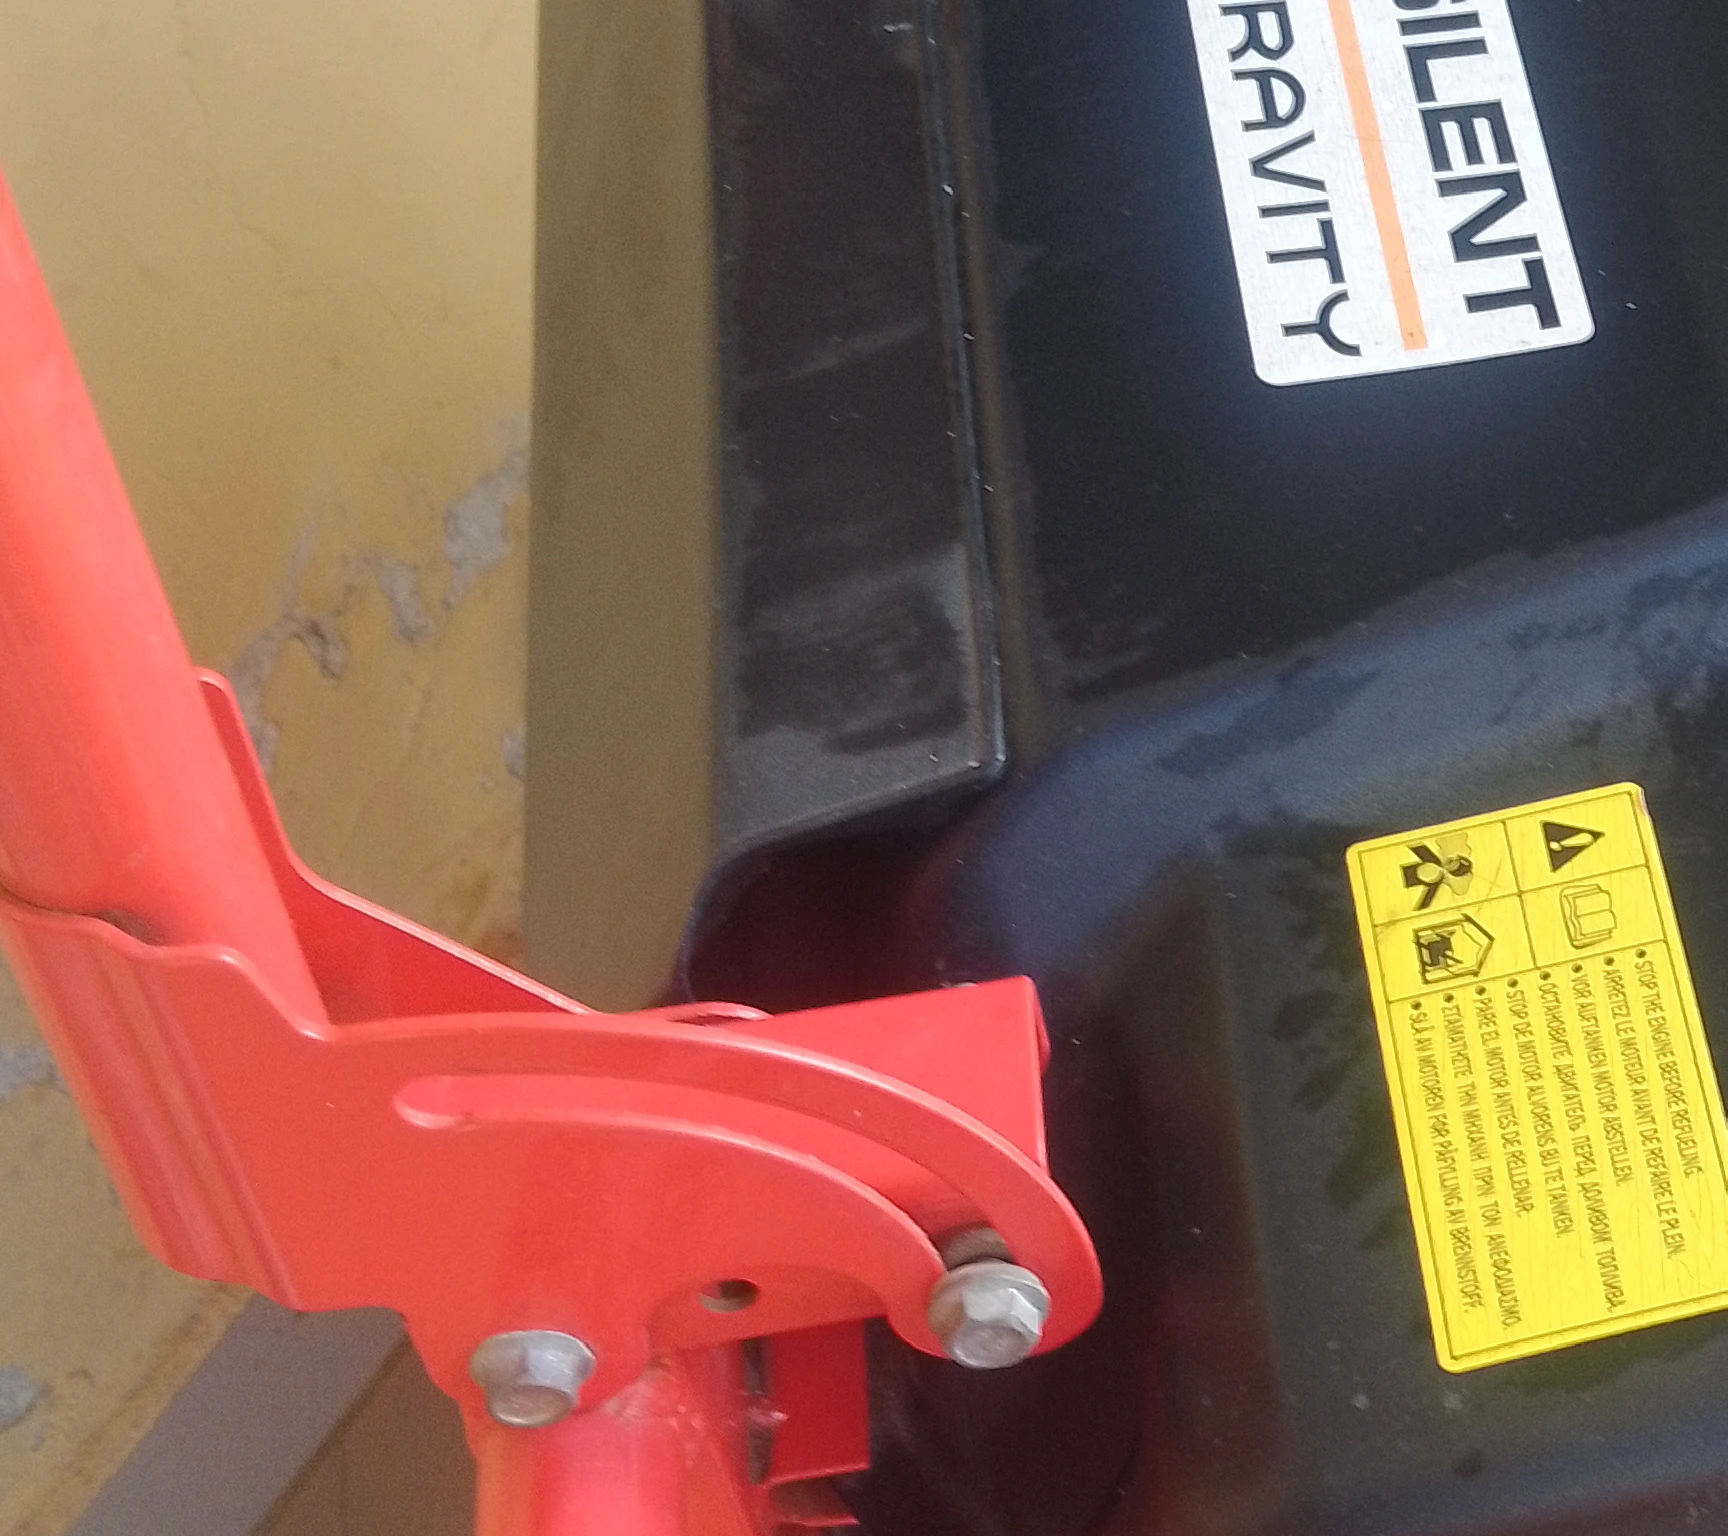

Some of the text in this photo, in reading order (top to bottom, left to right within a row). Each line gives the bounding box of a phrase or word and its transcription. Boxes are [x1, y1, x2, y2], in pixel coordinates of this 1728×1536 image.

[1569, 973, 1593, 1000] VOR
[1633, 959, 1659, 992] STOP
[1473, 996, 1497, 1029] PARE
[1505, 988, 1529, 1022] STOP
[1641, 990, 1664, 1015] THE
[1412, 1034, 1434, 1053] AV
[1479, 1029, 1501, 1047] EL
[1512, 1020, 1533, 1040] DE
[1575, 999, 1608, 1069] AUFTANKEN
[1613, 1019, 1635, 1037] LE
[1647, 1014, 1675, 1060] ENGINE
[1483, 1045, 1510, 1090] MOTOR
[1515, 1038, 1543, 1083] MOTOR
[1617, 1035, 1647, 1086] MOTEUR
[1416, 1053, 1445, 1112] MOTOREN
[1591, 1069, 1619, 1114] MOTOR
[1657, 1059, 1687, 1108] BEFORE
[1491, 1088, 1518, 1131] ANTES
[1525, 1082, 1556, 1148] ALVORENS
[1629, 1085, 1657, 1128] AVANT
[1500, 1129, 1522, 1149] DE
[1638, 1126, 1661, 1146] DE
[1542, 1166, 1564, 1184] TE
[1643, 1145, 1674, 1201] REFAIRE
[1444, 1205, 1467, 1226] AV
[1655, 1199, 1678, 1217] LE
